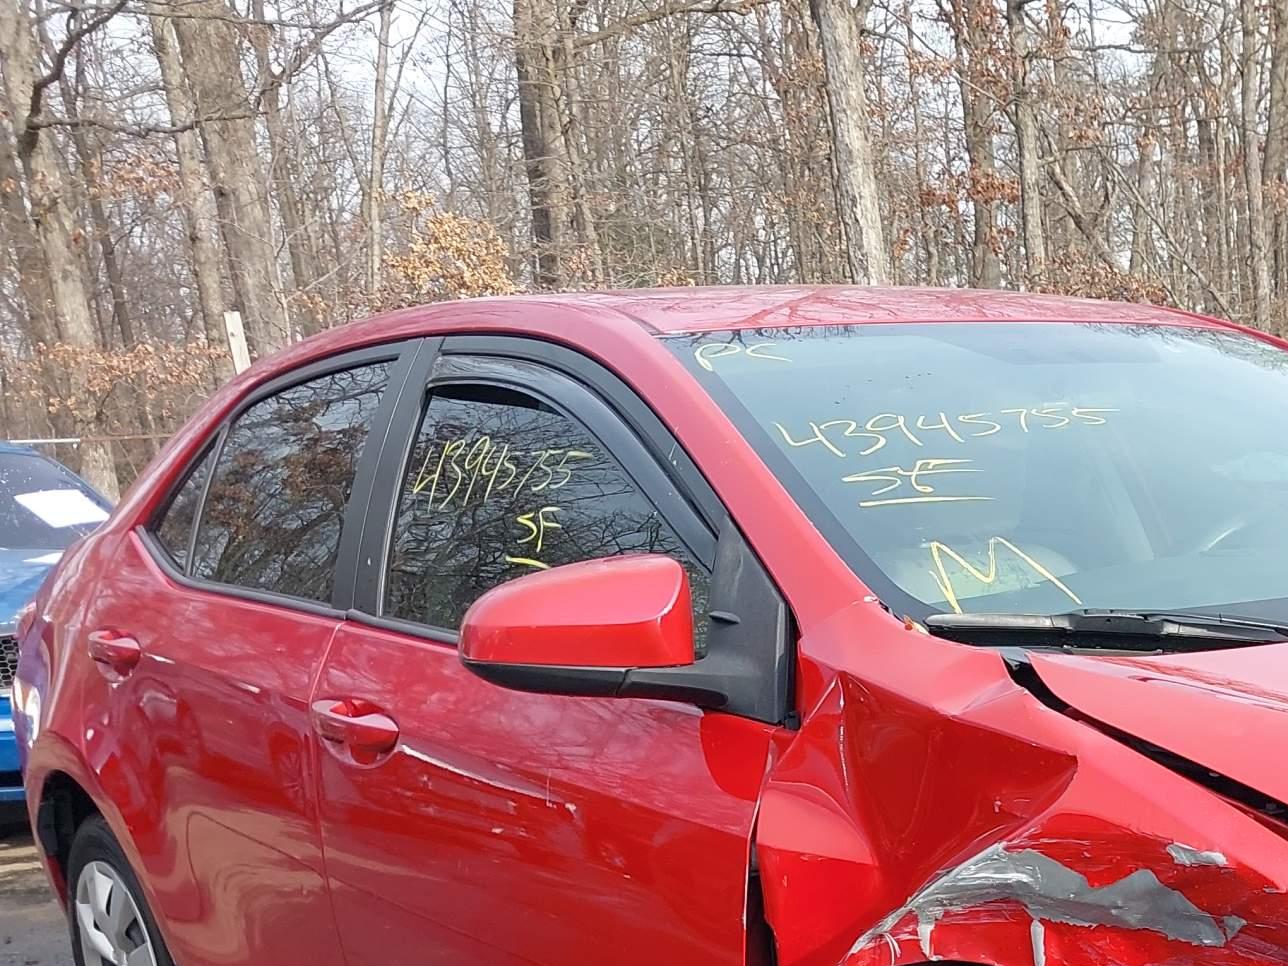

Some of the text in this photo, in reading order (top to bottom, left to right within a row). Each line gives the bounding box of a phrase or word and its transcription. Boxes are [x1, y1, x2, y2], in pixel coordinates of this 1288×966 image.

[772, 402, 1121, 458] 43945755
[412, 435, 594, 514] 43945755
[515, 506, 562, 553] SF
